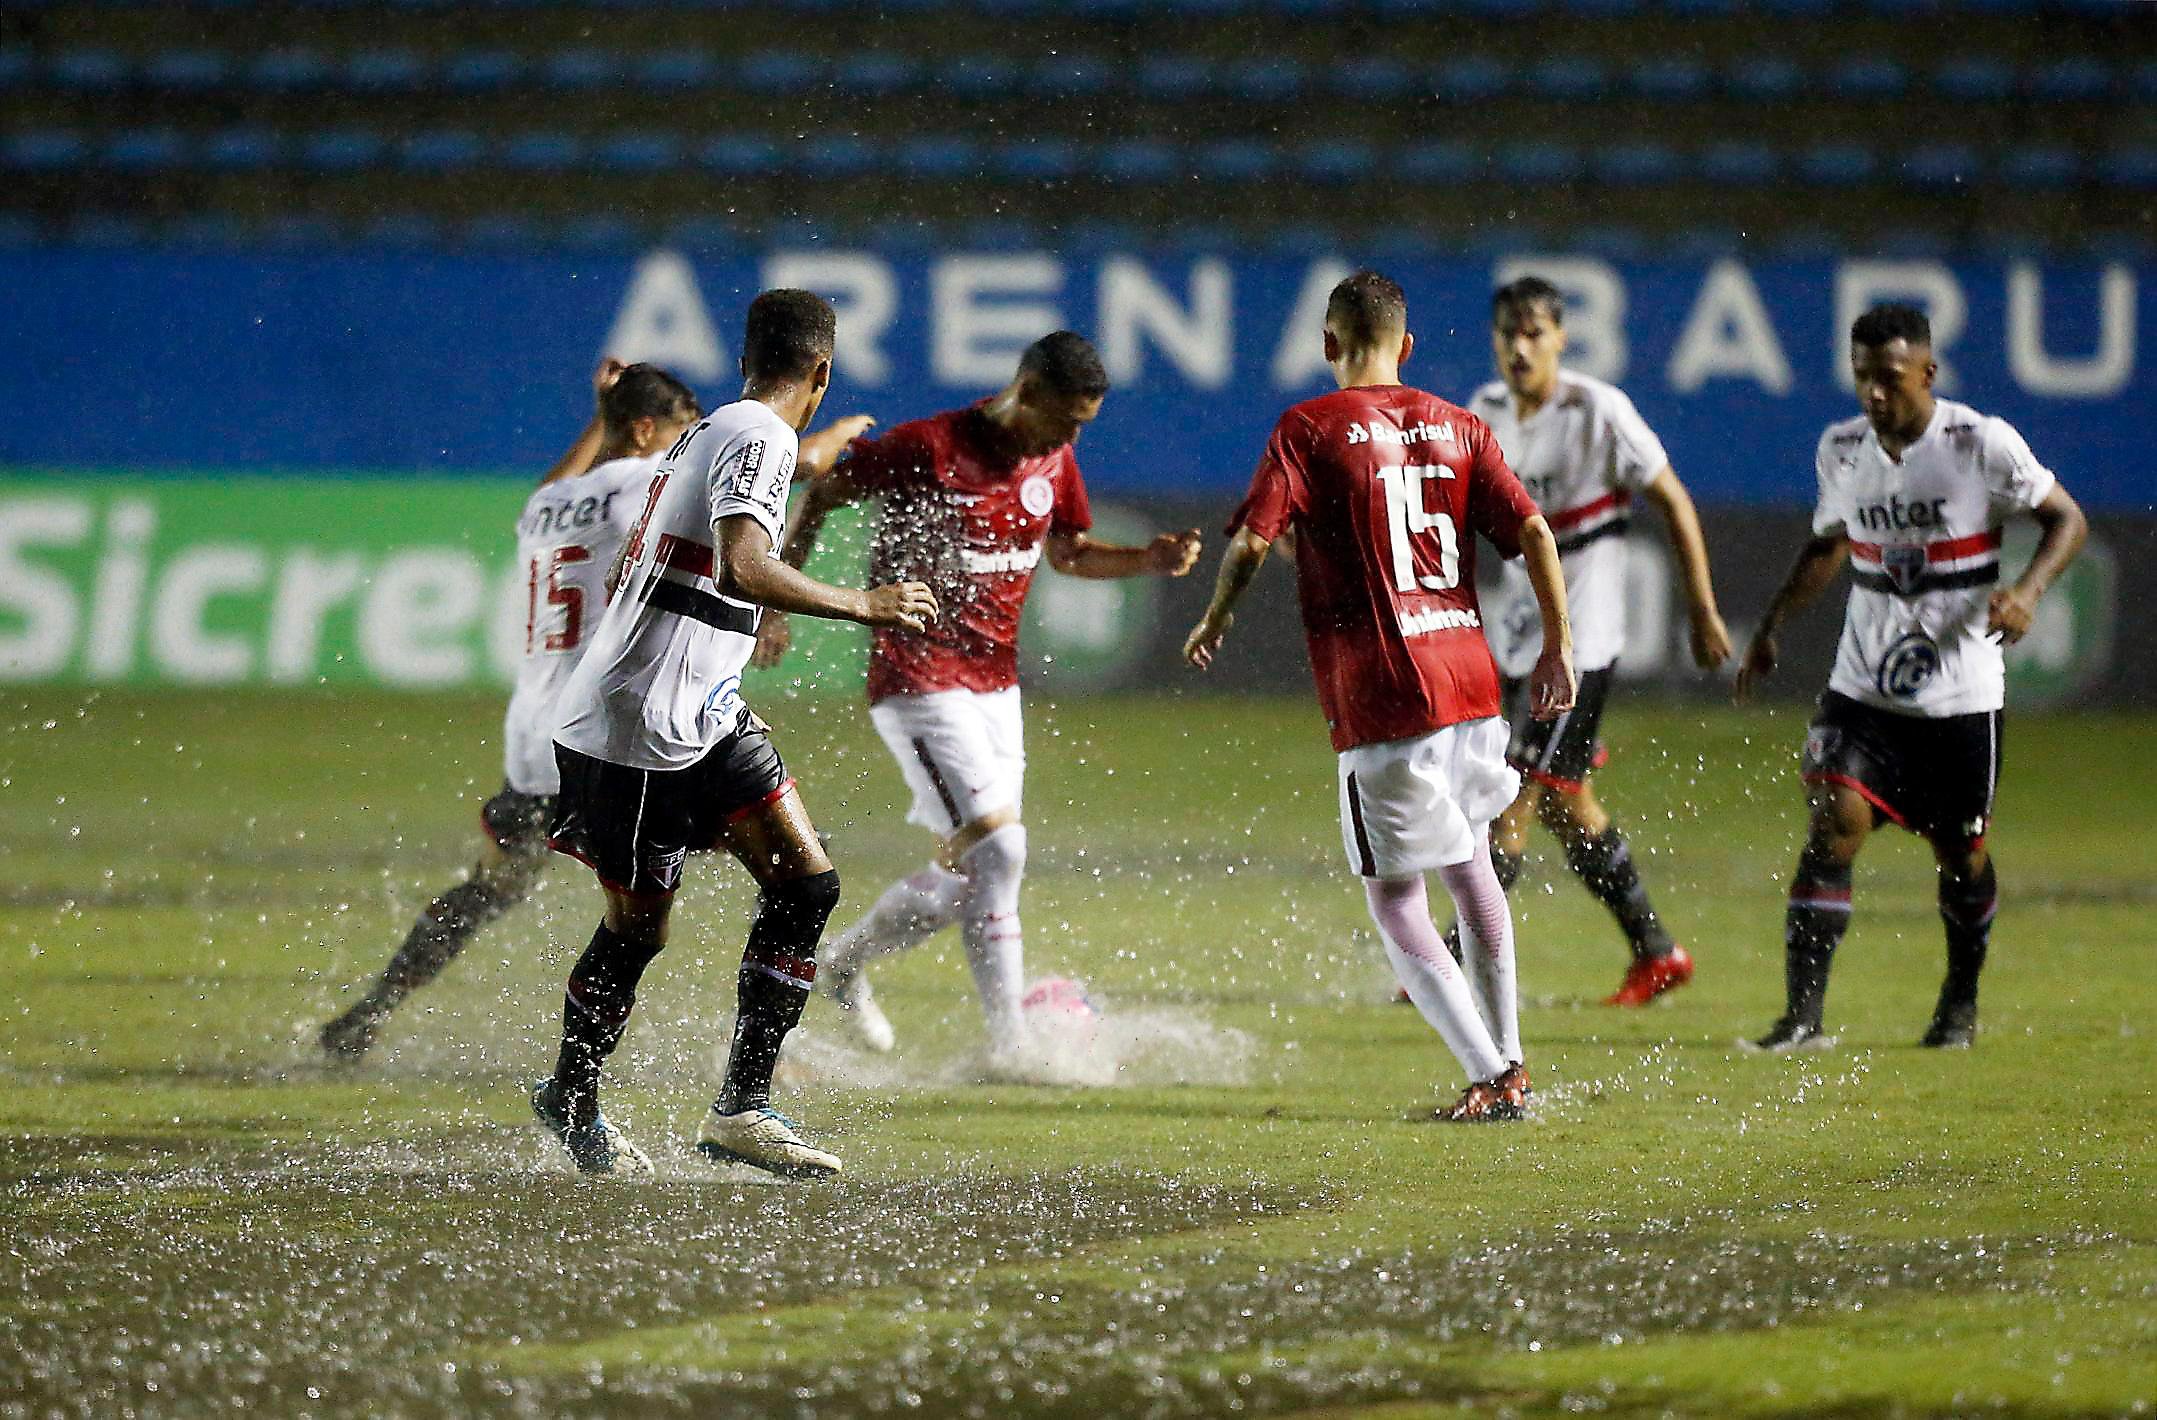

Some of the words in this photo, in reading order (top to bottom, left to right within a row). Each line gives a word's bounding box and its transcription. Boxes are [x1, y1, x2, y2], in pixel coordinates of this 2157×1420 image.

[1490, 258, 2138, 399] BARU
[1368, 420, 1455, 445] Banrisul
[528, 489, 620, 535] nter
[1376, 464, 1459, 592] 15
[1858, 494, 1946, 529] inter
[527, 546, 591, 655] 15
